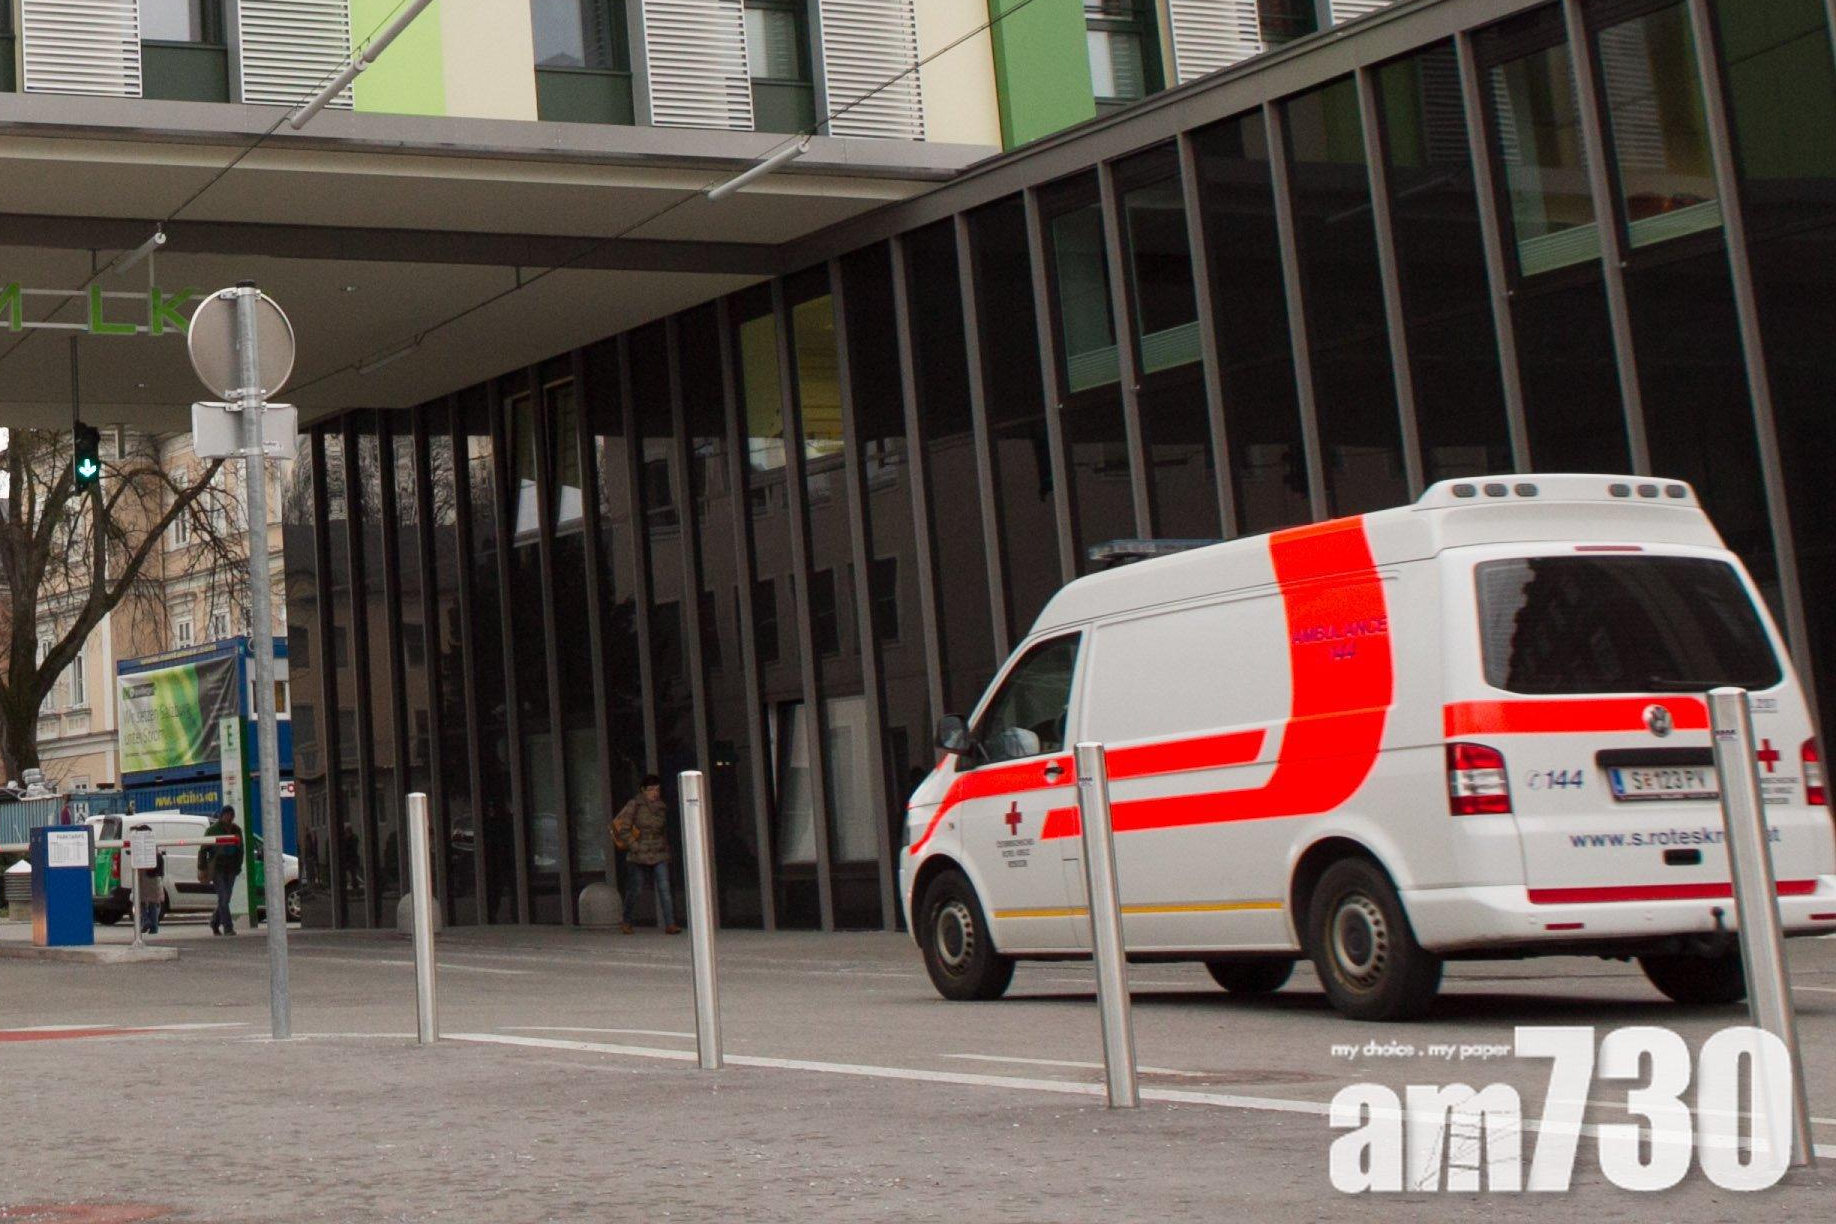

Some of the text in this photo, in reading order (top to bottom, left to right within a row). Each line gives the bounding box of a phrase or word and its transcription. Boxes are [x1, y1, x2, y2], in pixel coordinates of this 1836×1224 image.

[89, 283, 199, 336] LK
[1292, 617, 1388, 643] AMBULANCE
[1544, 769, 1583, 790] 144
